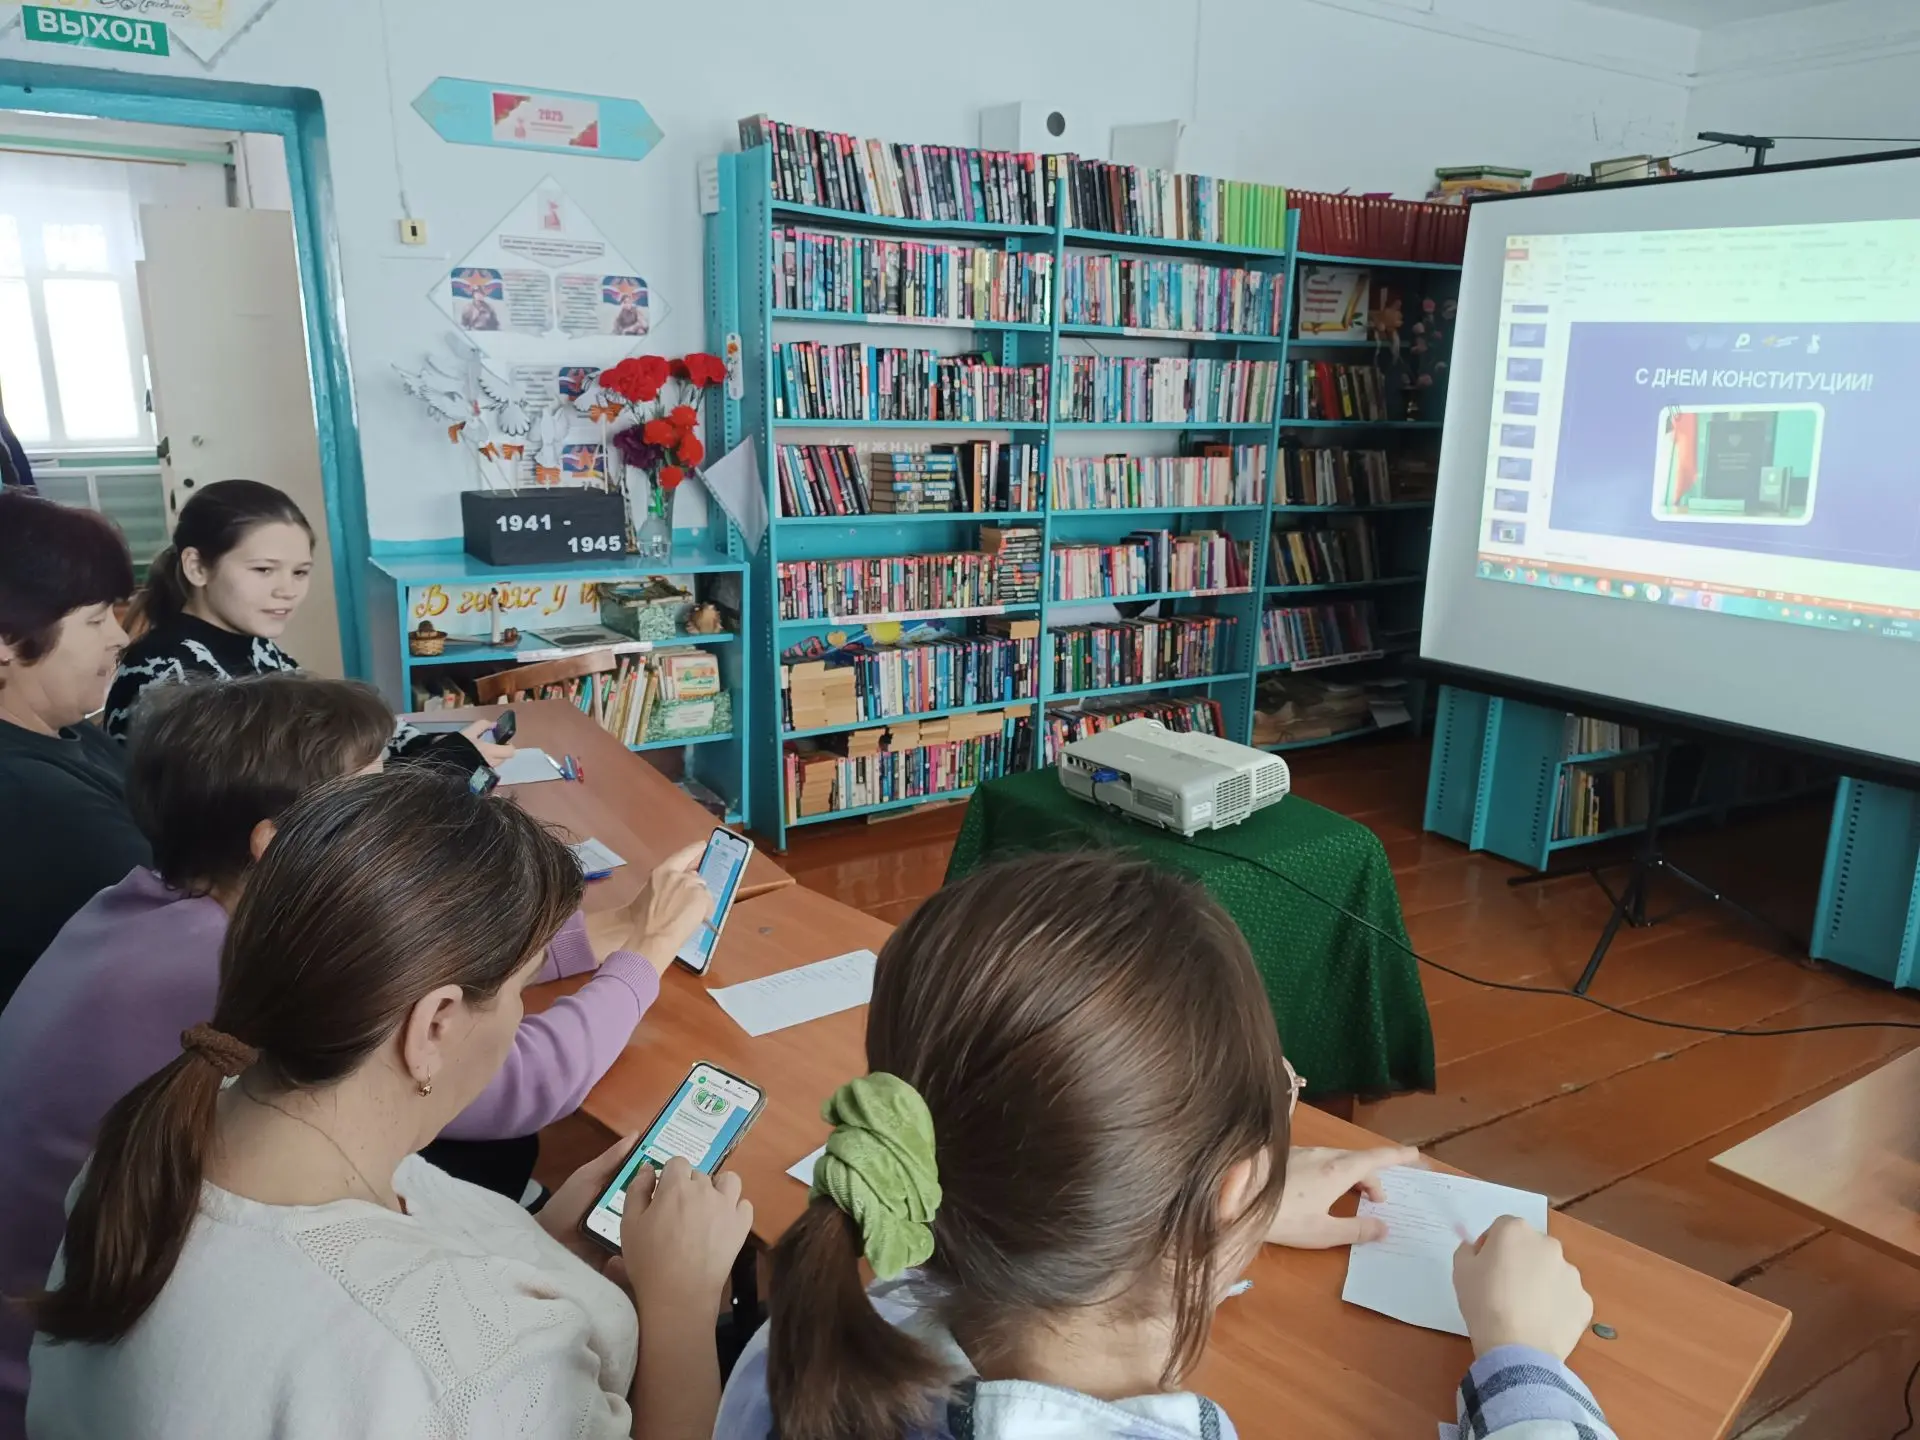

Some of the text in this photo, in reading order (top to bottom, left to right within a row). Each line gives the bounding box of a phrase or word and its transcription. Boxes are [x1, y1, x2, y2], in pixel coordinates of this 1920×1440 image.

[36, 9, 156, 50] ВЫХОД
[1635, 368, 1874, 394] С ДНЕМ КОНСТИТУЦИИ!
[496, 513, 552, 532] 1941
[567, 535, 622, 553] 1945
[414, 584, 449, 618] В
[543, 584, 568, 616] у
